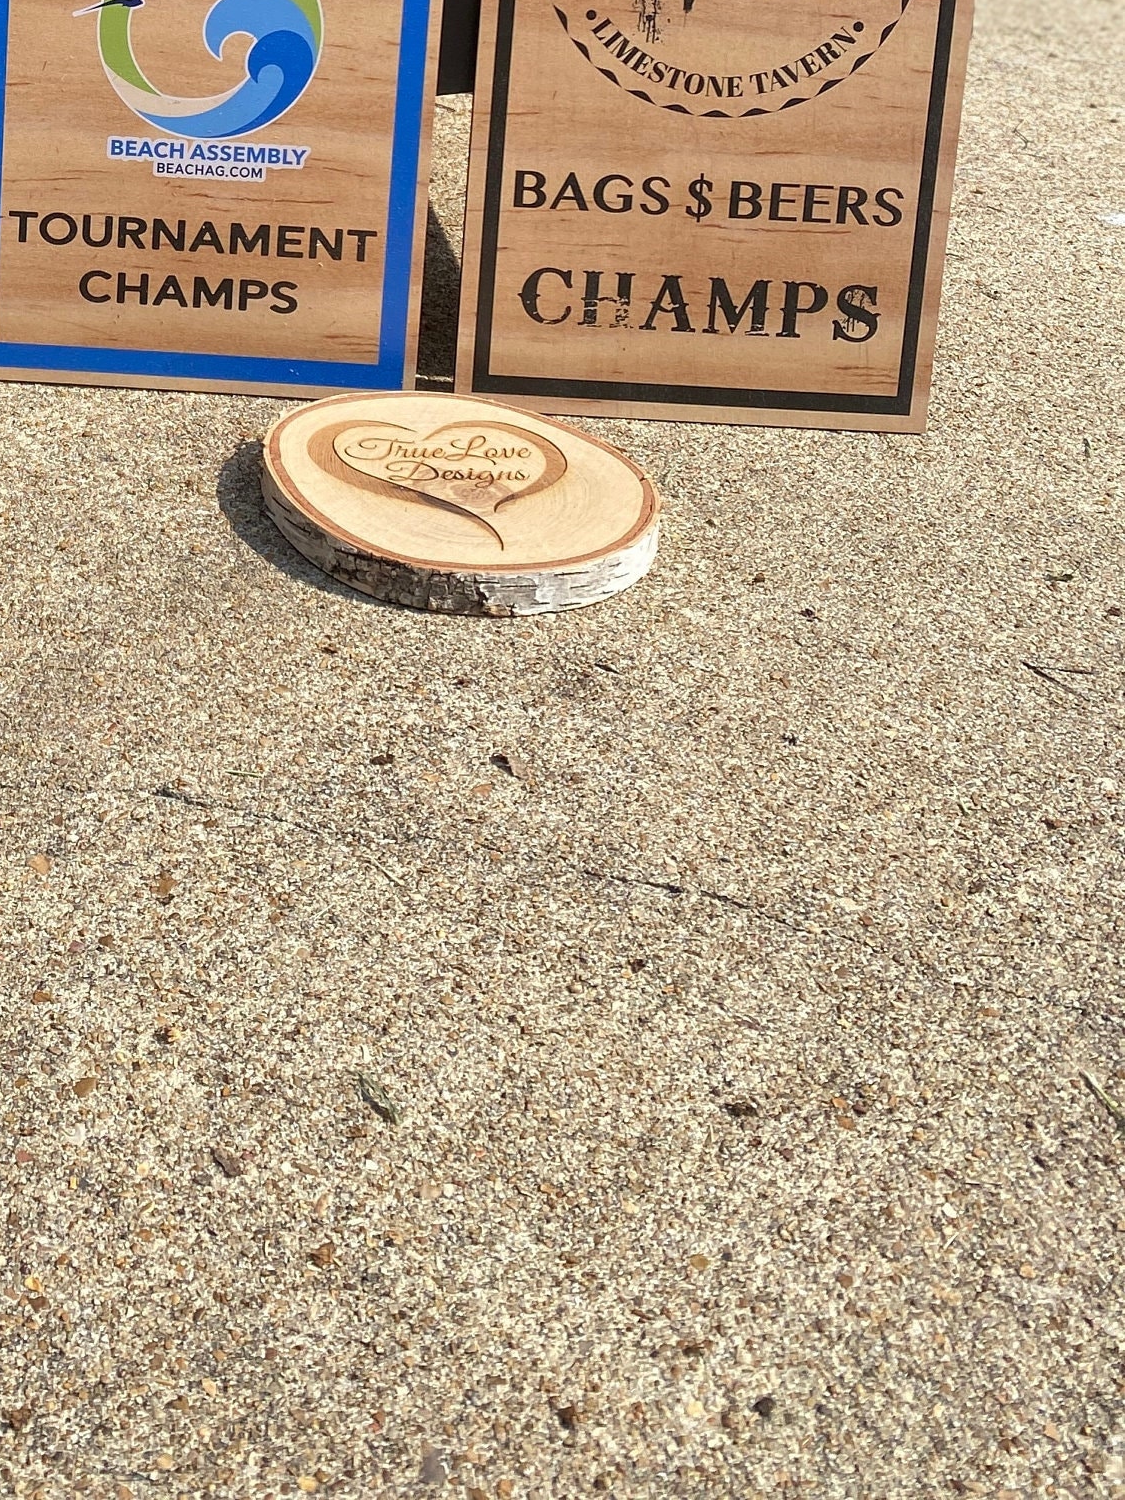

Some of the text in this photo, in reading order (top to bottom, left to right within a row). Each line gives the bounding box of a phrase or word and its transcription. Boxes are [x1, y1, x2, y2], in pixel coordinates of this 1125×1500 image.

[591, 18, 855, 98] LIMESTONE TAVERN
[110, 140, 307, 166] BEACH ASSEMBLY
[156, 163, 263, 179] BEACHAG.COM
[513, 170, 904, 227] BAGS $ BEERS
[9, 210, 377, 262] TOURNAMENT
[78, 270, 299, 314] CHAMPS
[517, 267, 879, 343] CHAMPS
[386, 460, 530, 489] Designs
